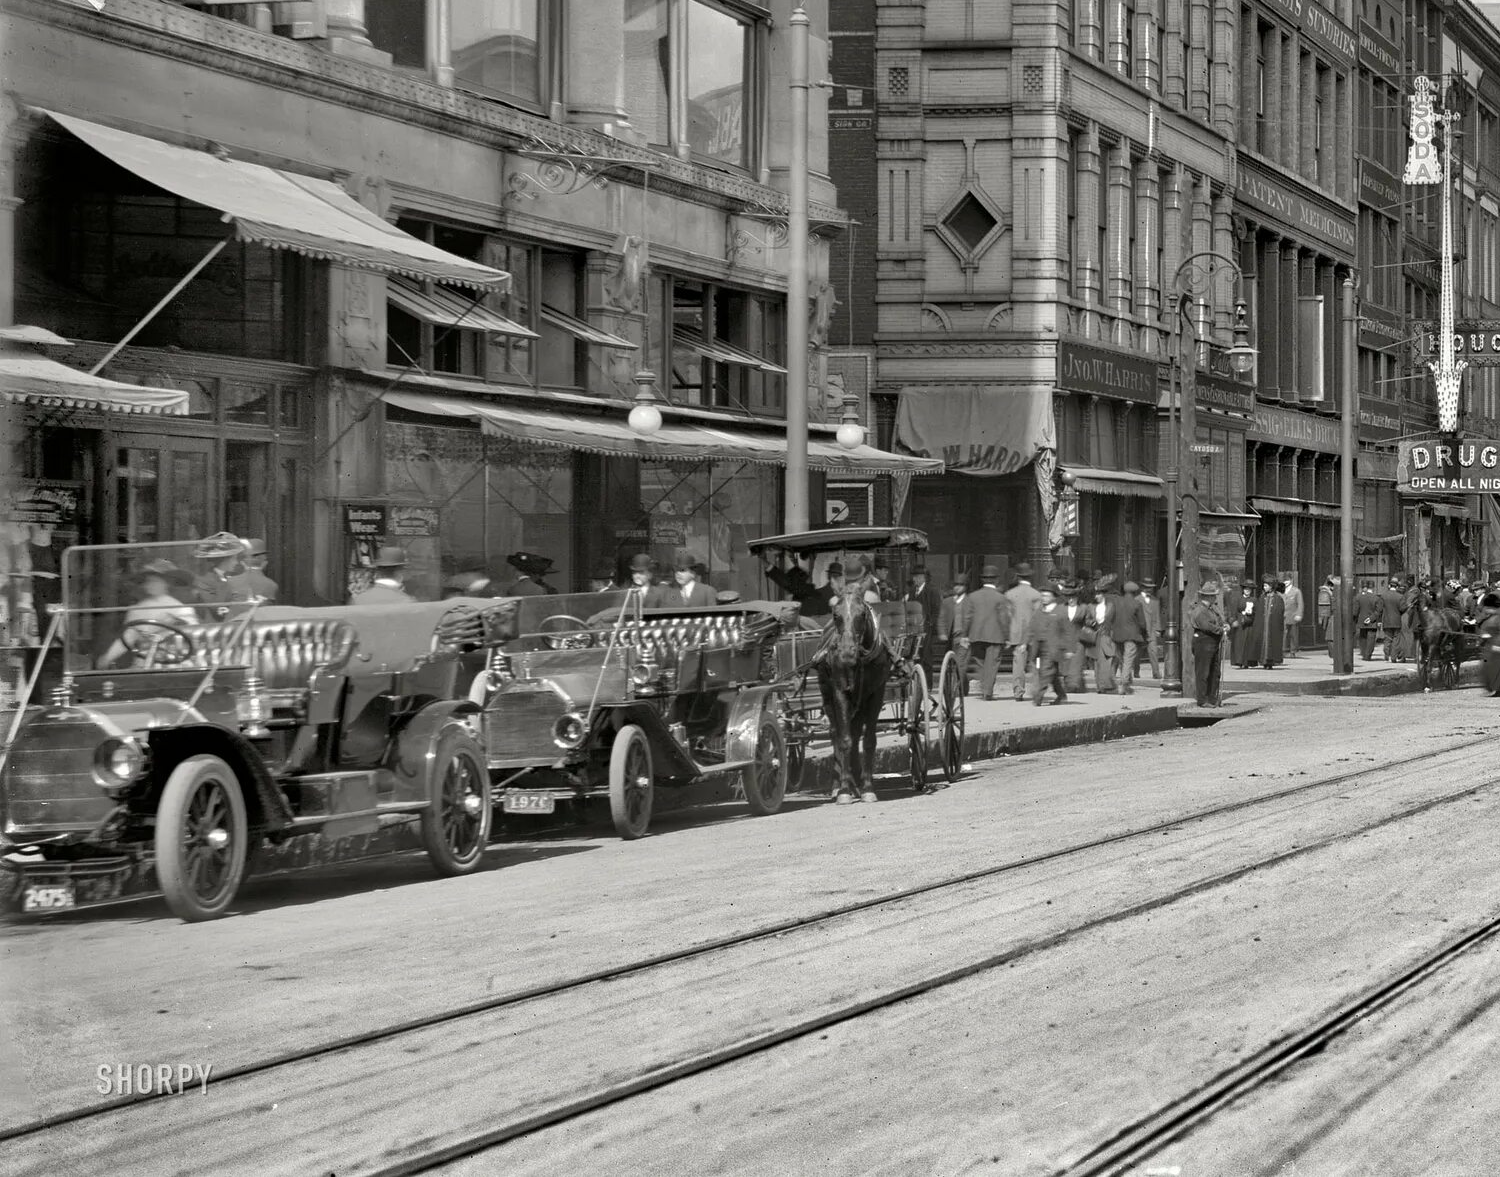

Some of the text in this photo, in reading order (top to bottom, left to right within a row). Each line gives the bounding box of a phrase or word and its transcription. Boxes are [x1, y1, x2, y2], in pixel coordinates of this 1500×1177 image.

[1414, 101, 1432, 180] SODA
[1239, 170, 1355, 247] PATENT MEDICINES
[1411, 477, 1446, 489] OPEN
[1450, 477, 1475, 490] ALL
[24, 888, 67, 909] 2475
